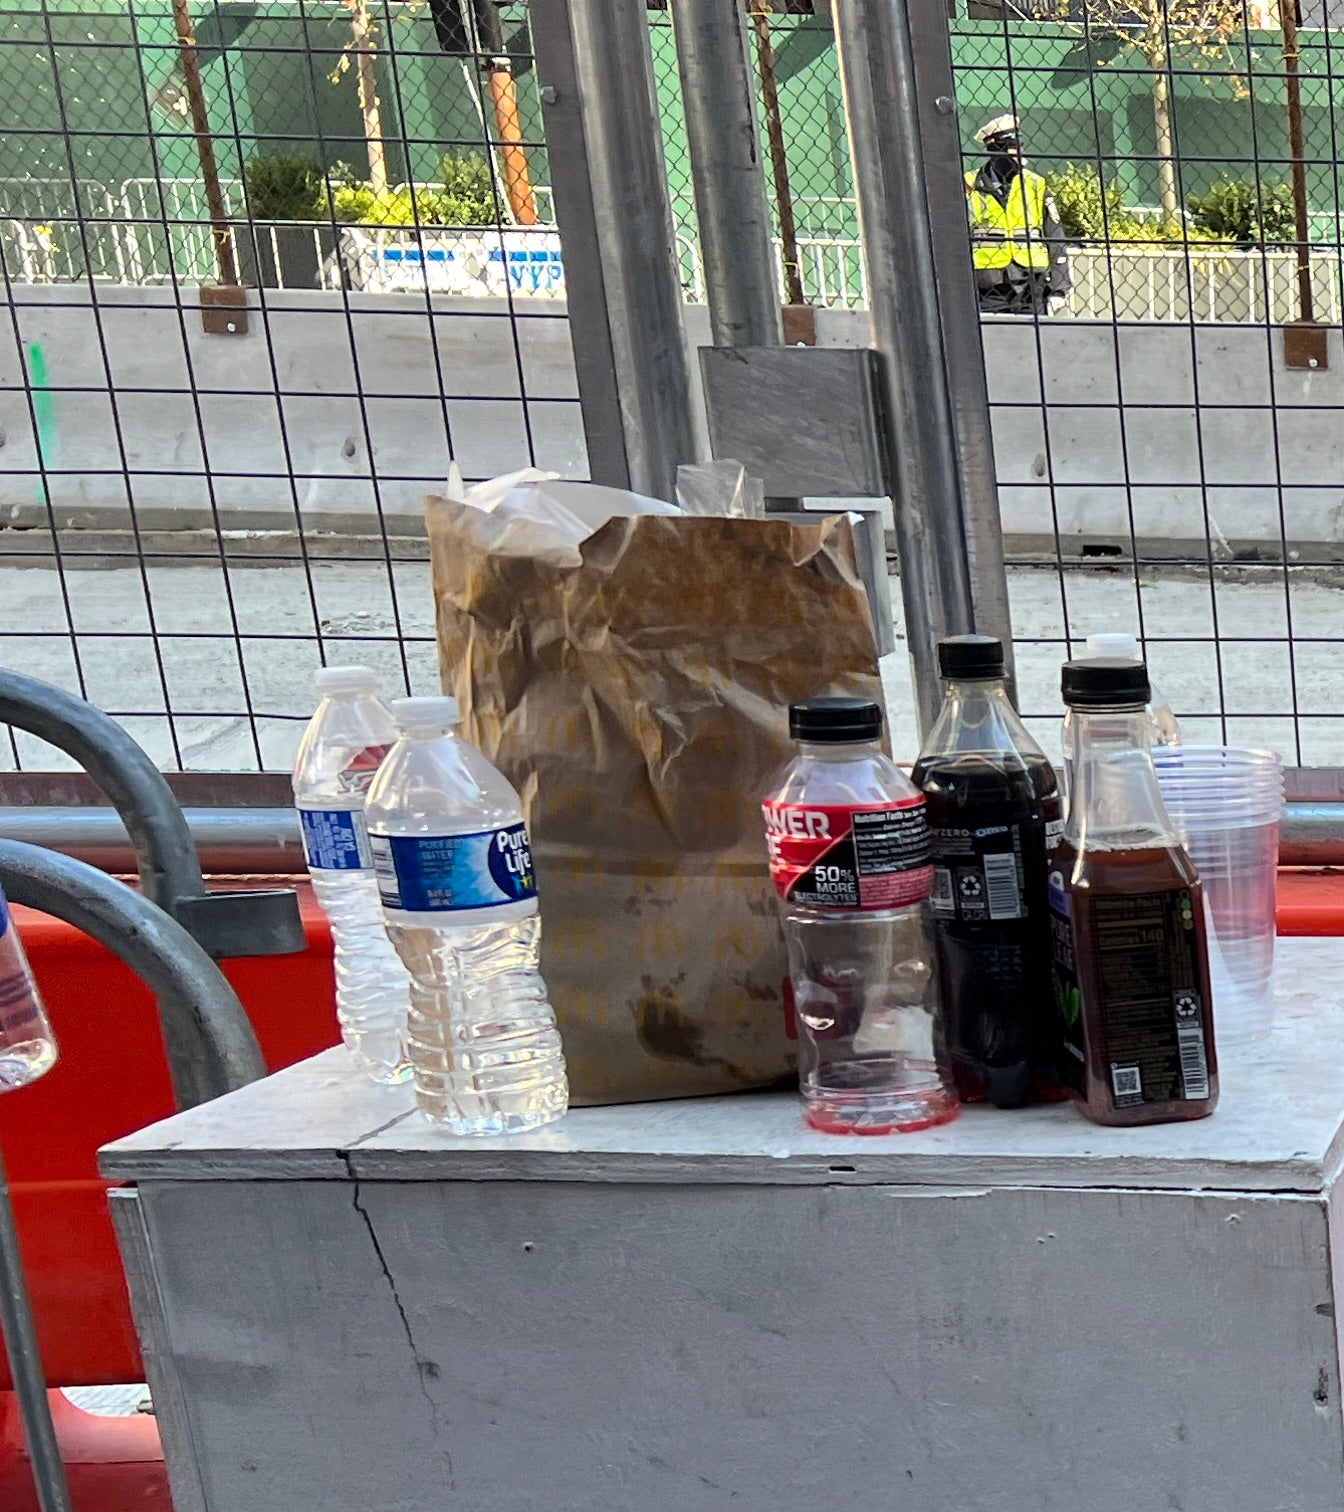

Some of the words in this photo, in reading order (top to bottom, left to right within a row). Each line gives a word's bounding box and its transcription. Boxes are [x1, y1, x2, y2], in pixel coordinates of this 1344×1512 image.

[496, 830, 529, 853] Pure
[504, 850, 532, 876] Life
[815, 866, 855, 882] 50%
[816, 882, 856, 894] MORE
